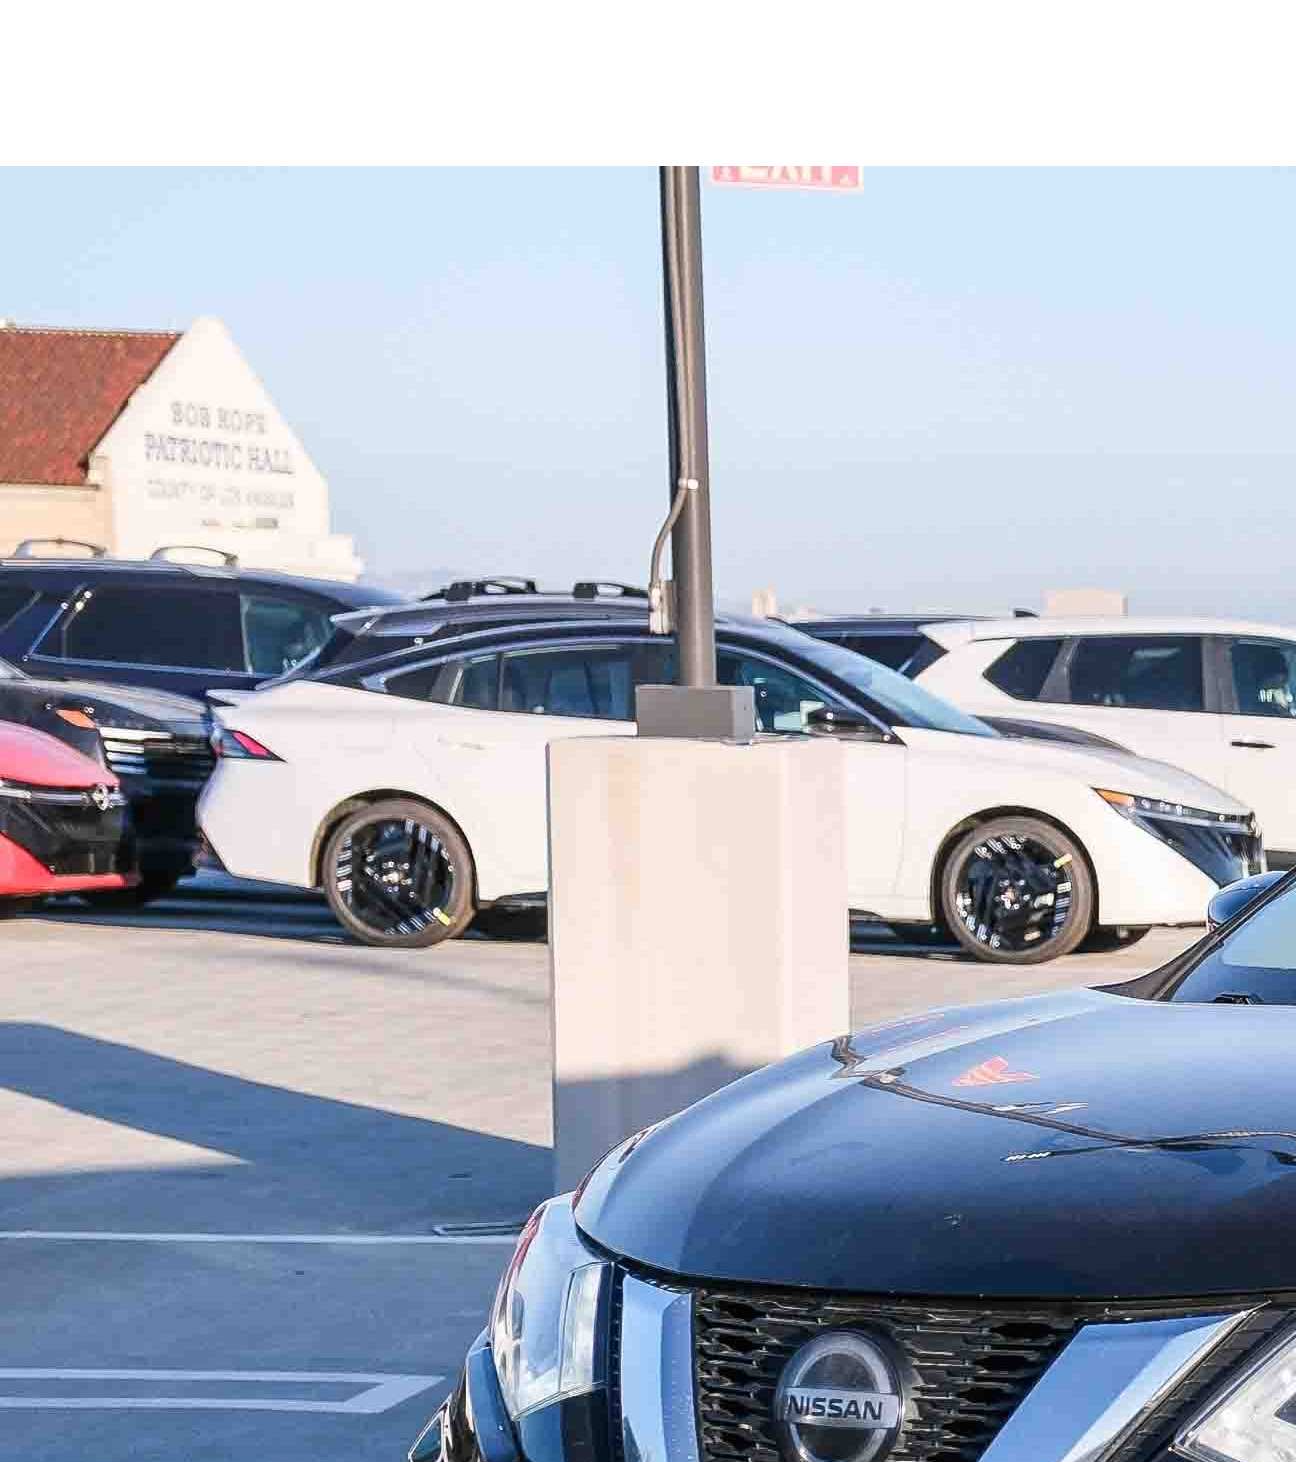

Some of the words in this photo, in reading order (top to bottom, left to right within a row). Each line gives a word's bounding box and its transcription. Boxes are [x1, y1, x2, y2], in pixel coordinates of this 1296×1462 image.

[144, 431, 242, 470] PATRIOTIC
[247, 447, 294, 475] HALL
[787, 1394, 882, 1420] NISSAN
